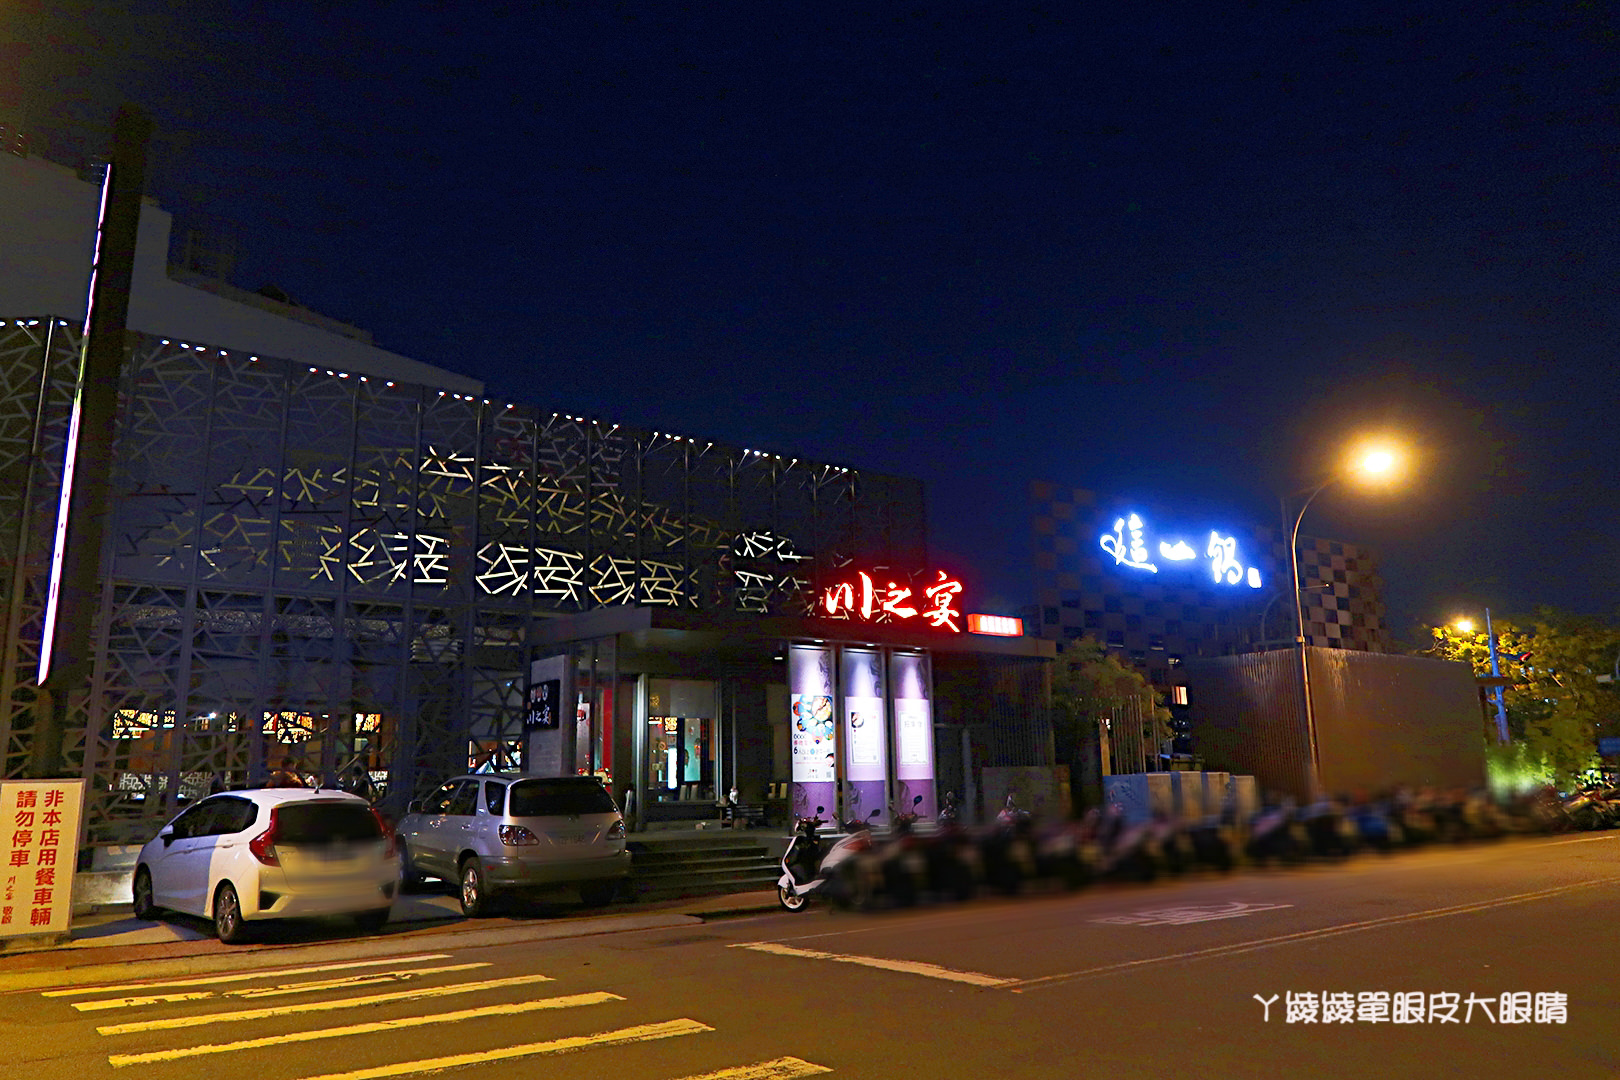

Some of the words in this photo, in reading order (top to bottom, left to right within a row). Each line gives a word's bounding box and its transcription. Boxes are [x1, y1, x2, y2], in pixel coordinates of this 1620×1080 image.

[1099, 513, 1244, 586] 這一鍋
[825, 570, 963, 633] 川之宴
[8, 790, 38, 868] 請勿停車
[30, 789, 65, 927] 非本店用餐車輛
